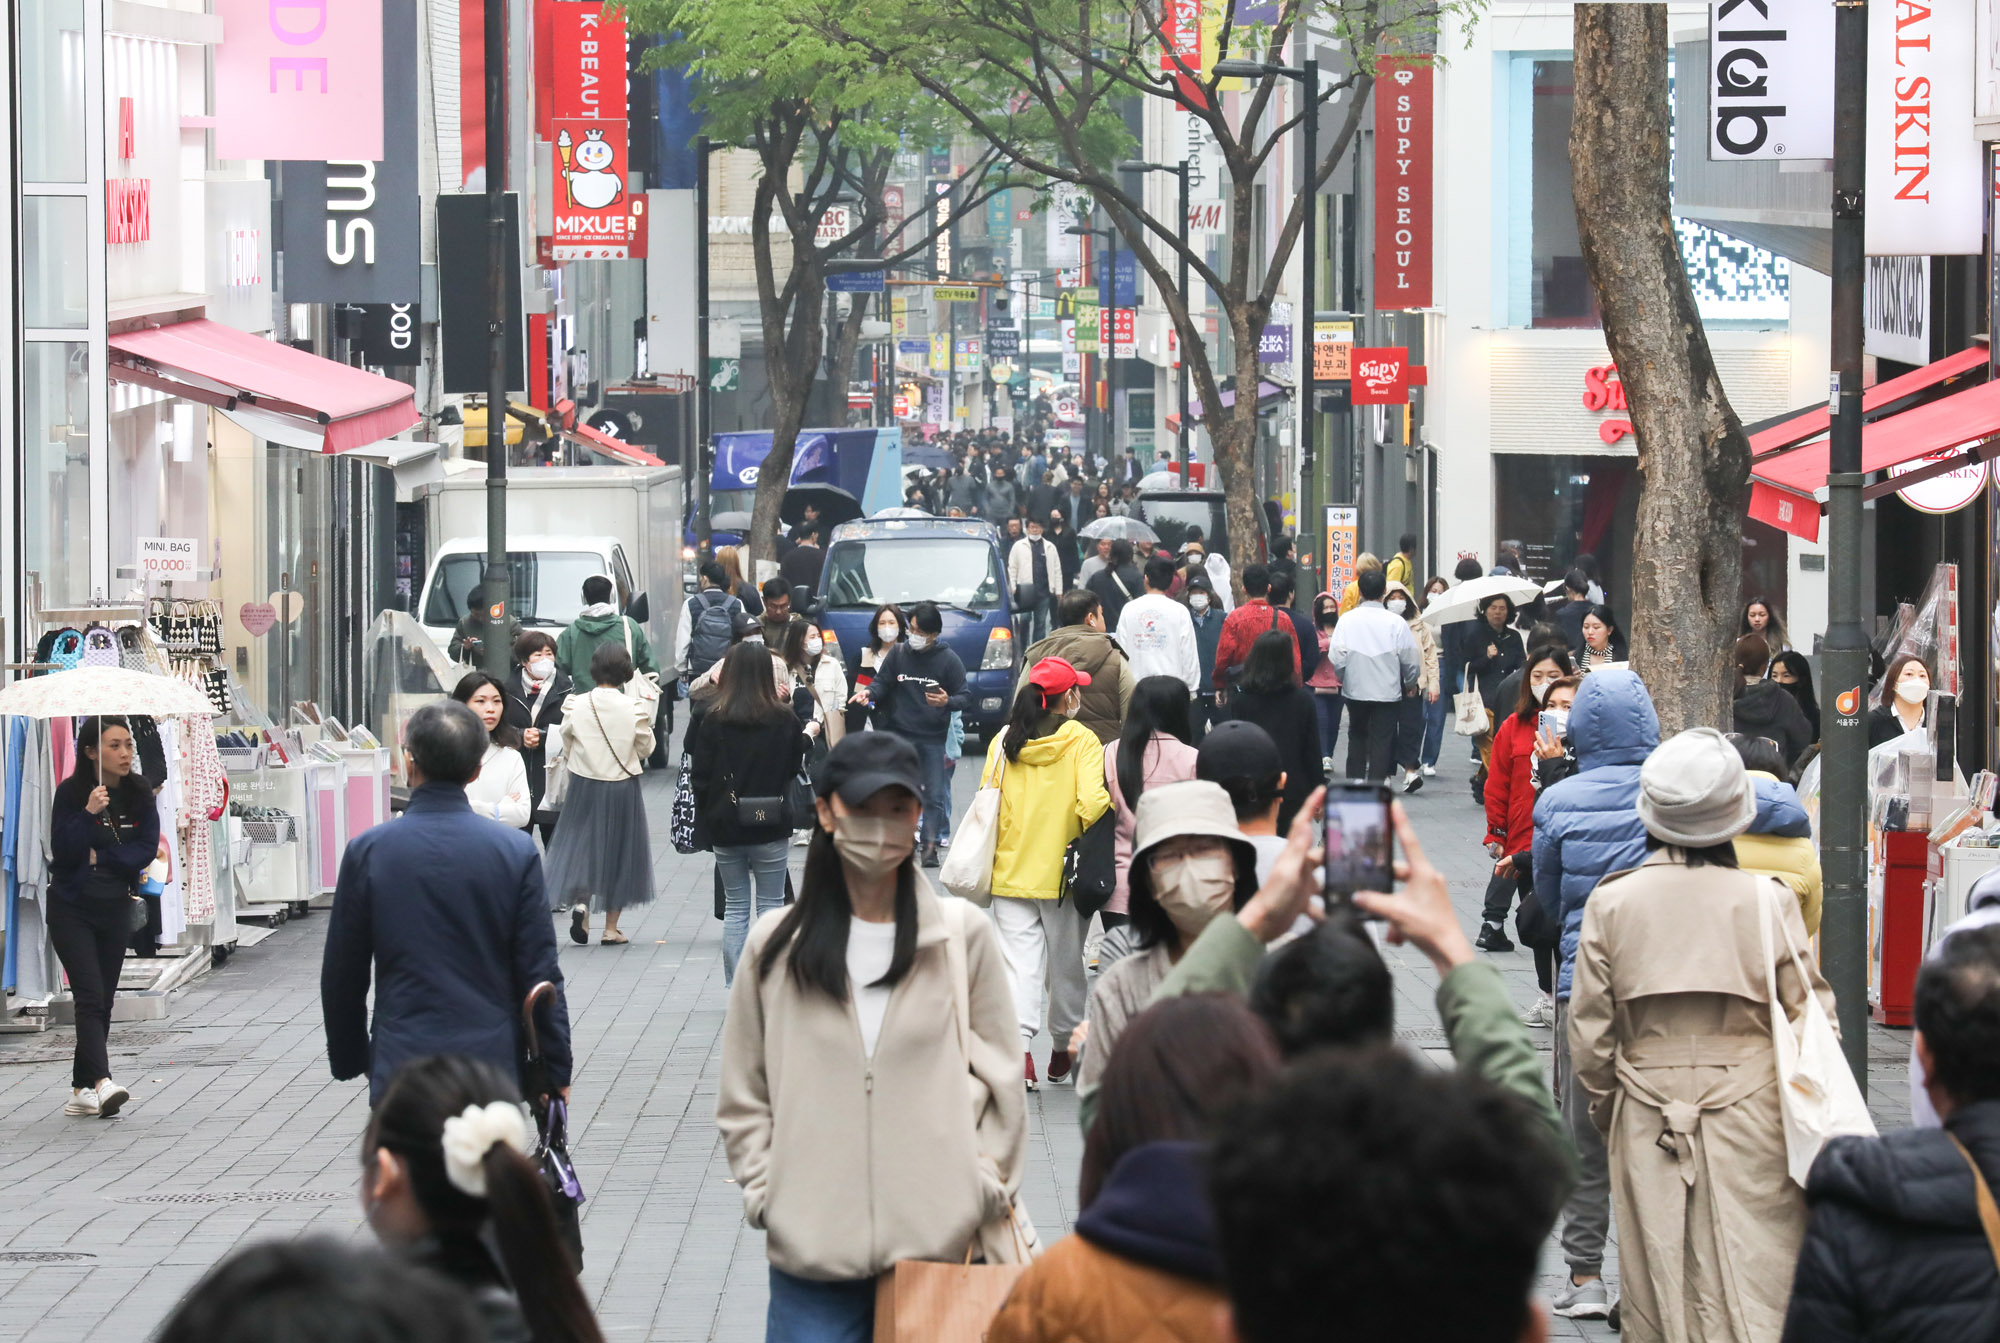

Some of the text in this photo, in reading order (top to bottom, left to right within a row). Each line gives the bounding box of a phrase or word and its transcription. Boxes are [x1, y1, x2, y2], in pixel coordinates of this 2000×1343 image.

[1176, 0, 1197, 53] SKIN
[1894, 0, 1932, 204] AL SKIN
[1187, 110, 1206, 187] enherb
[1395, 95, 1412, 288] SUPY SEOUL
[556, 216, 625, 233] MIXUE
[935, 290, 953, 298] CCTV
[1359, 360, 1399, 385] Supy
[170, 543, 191, 553] BAG
[143, 558, 185, 572] 10,000
